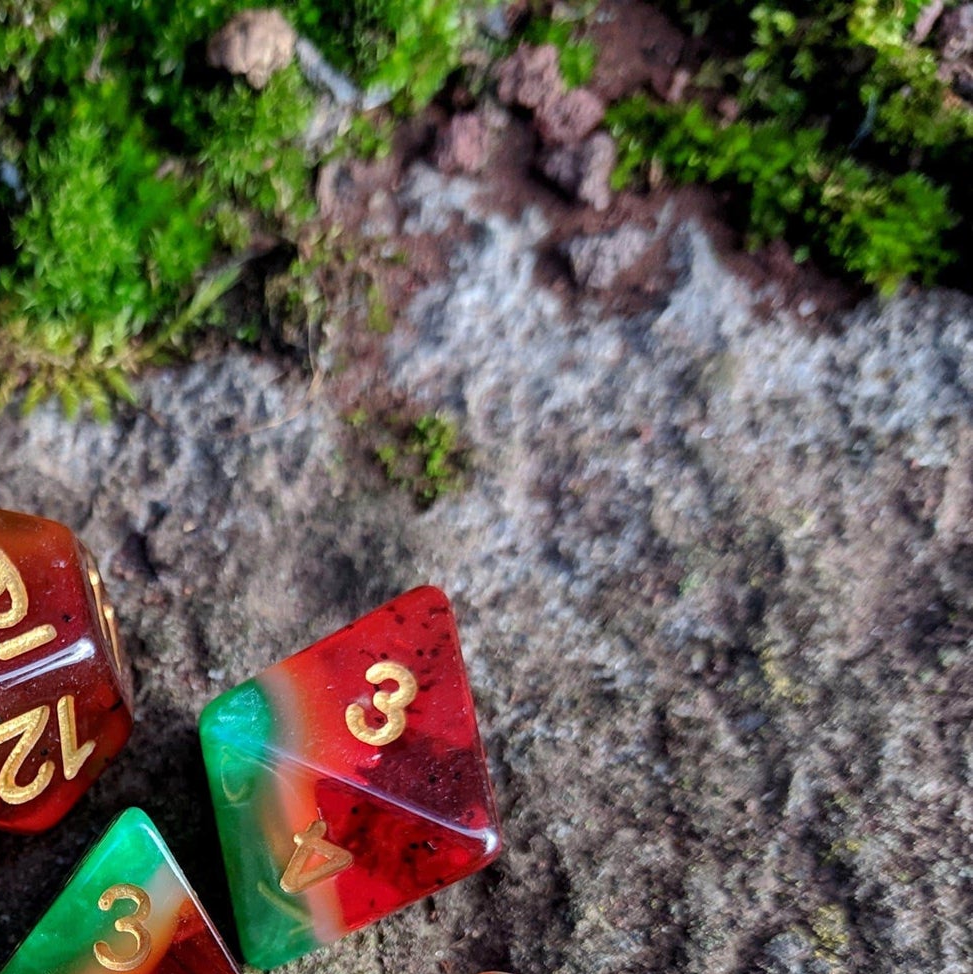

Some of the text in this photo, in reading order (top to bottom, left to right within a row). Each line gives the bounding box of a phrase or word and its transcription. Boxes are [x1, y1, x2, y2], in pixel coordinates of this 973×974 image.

[345, 661, 418, 747] 3
[279, 820, 354, 894] 4
[93, 883, 152, 972] 3
